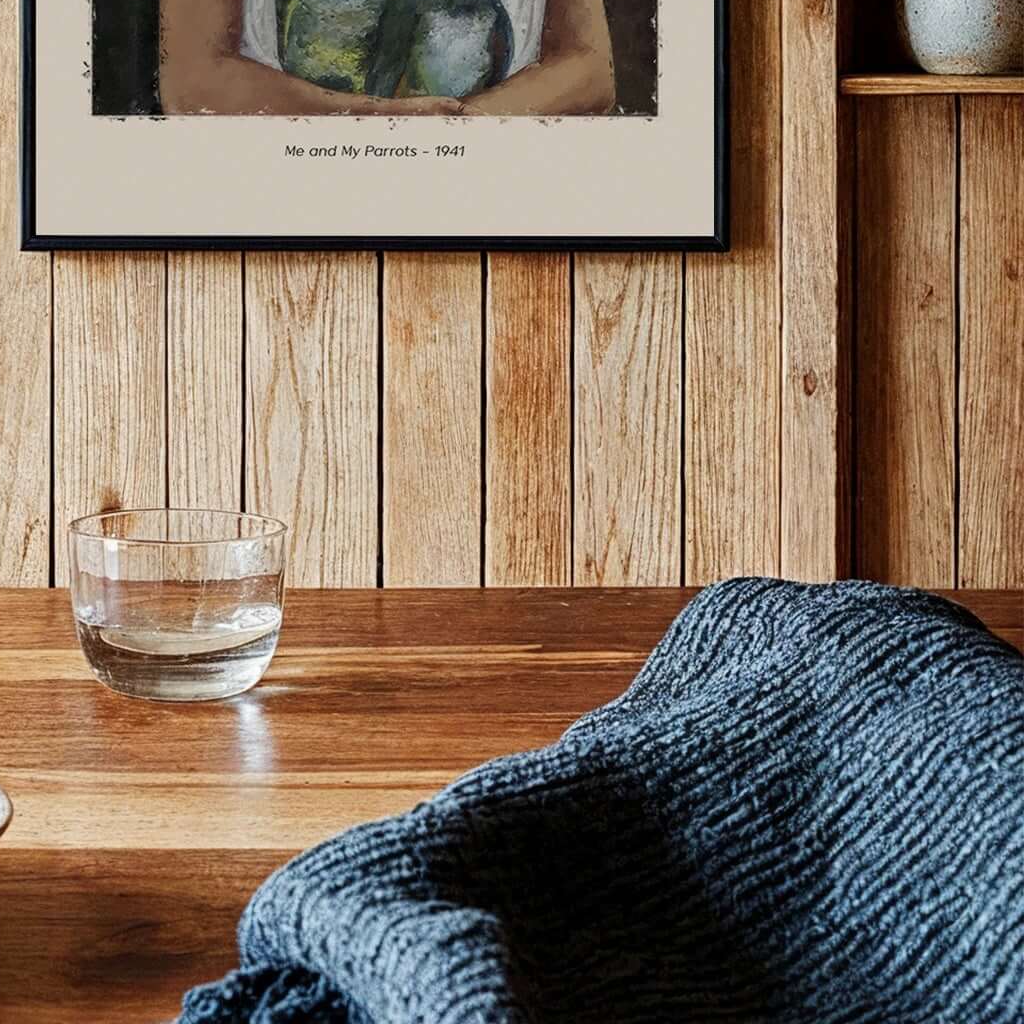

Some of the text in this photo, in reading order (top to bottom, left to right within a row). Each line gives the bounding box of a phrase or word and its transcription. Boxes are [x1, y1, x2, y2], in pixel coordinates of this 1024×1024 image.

[284, 144, 305, 157] Me
[309, 144, 337, 157] and
[341, 144, 361, 160] My
[364, 144, 418, 157] Parrots
[434, 144, 465, 157] 1941
